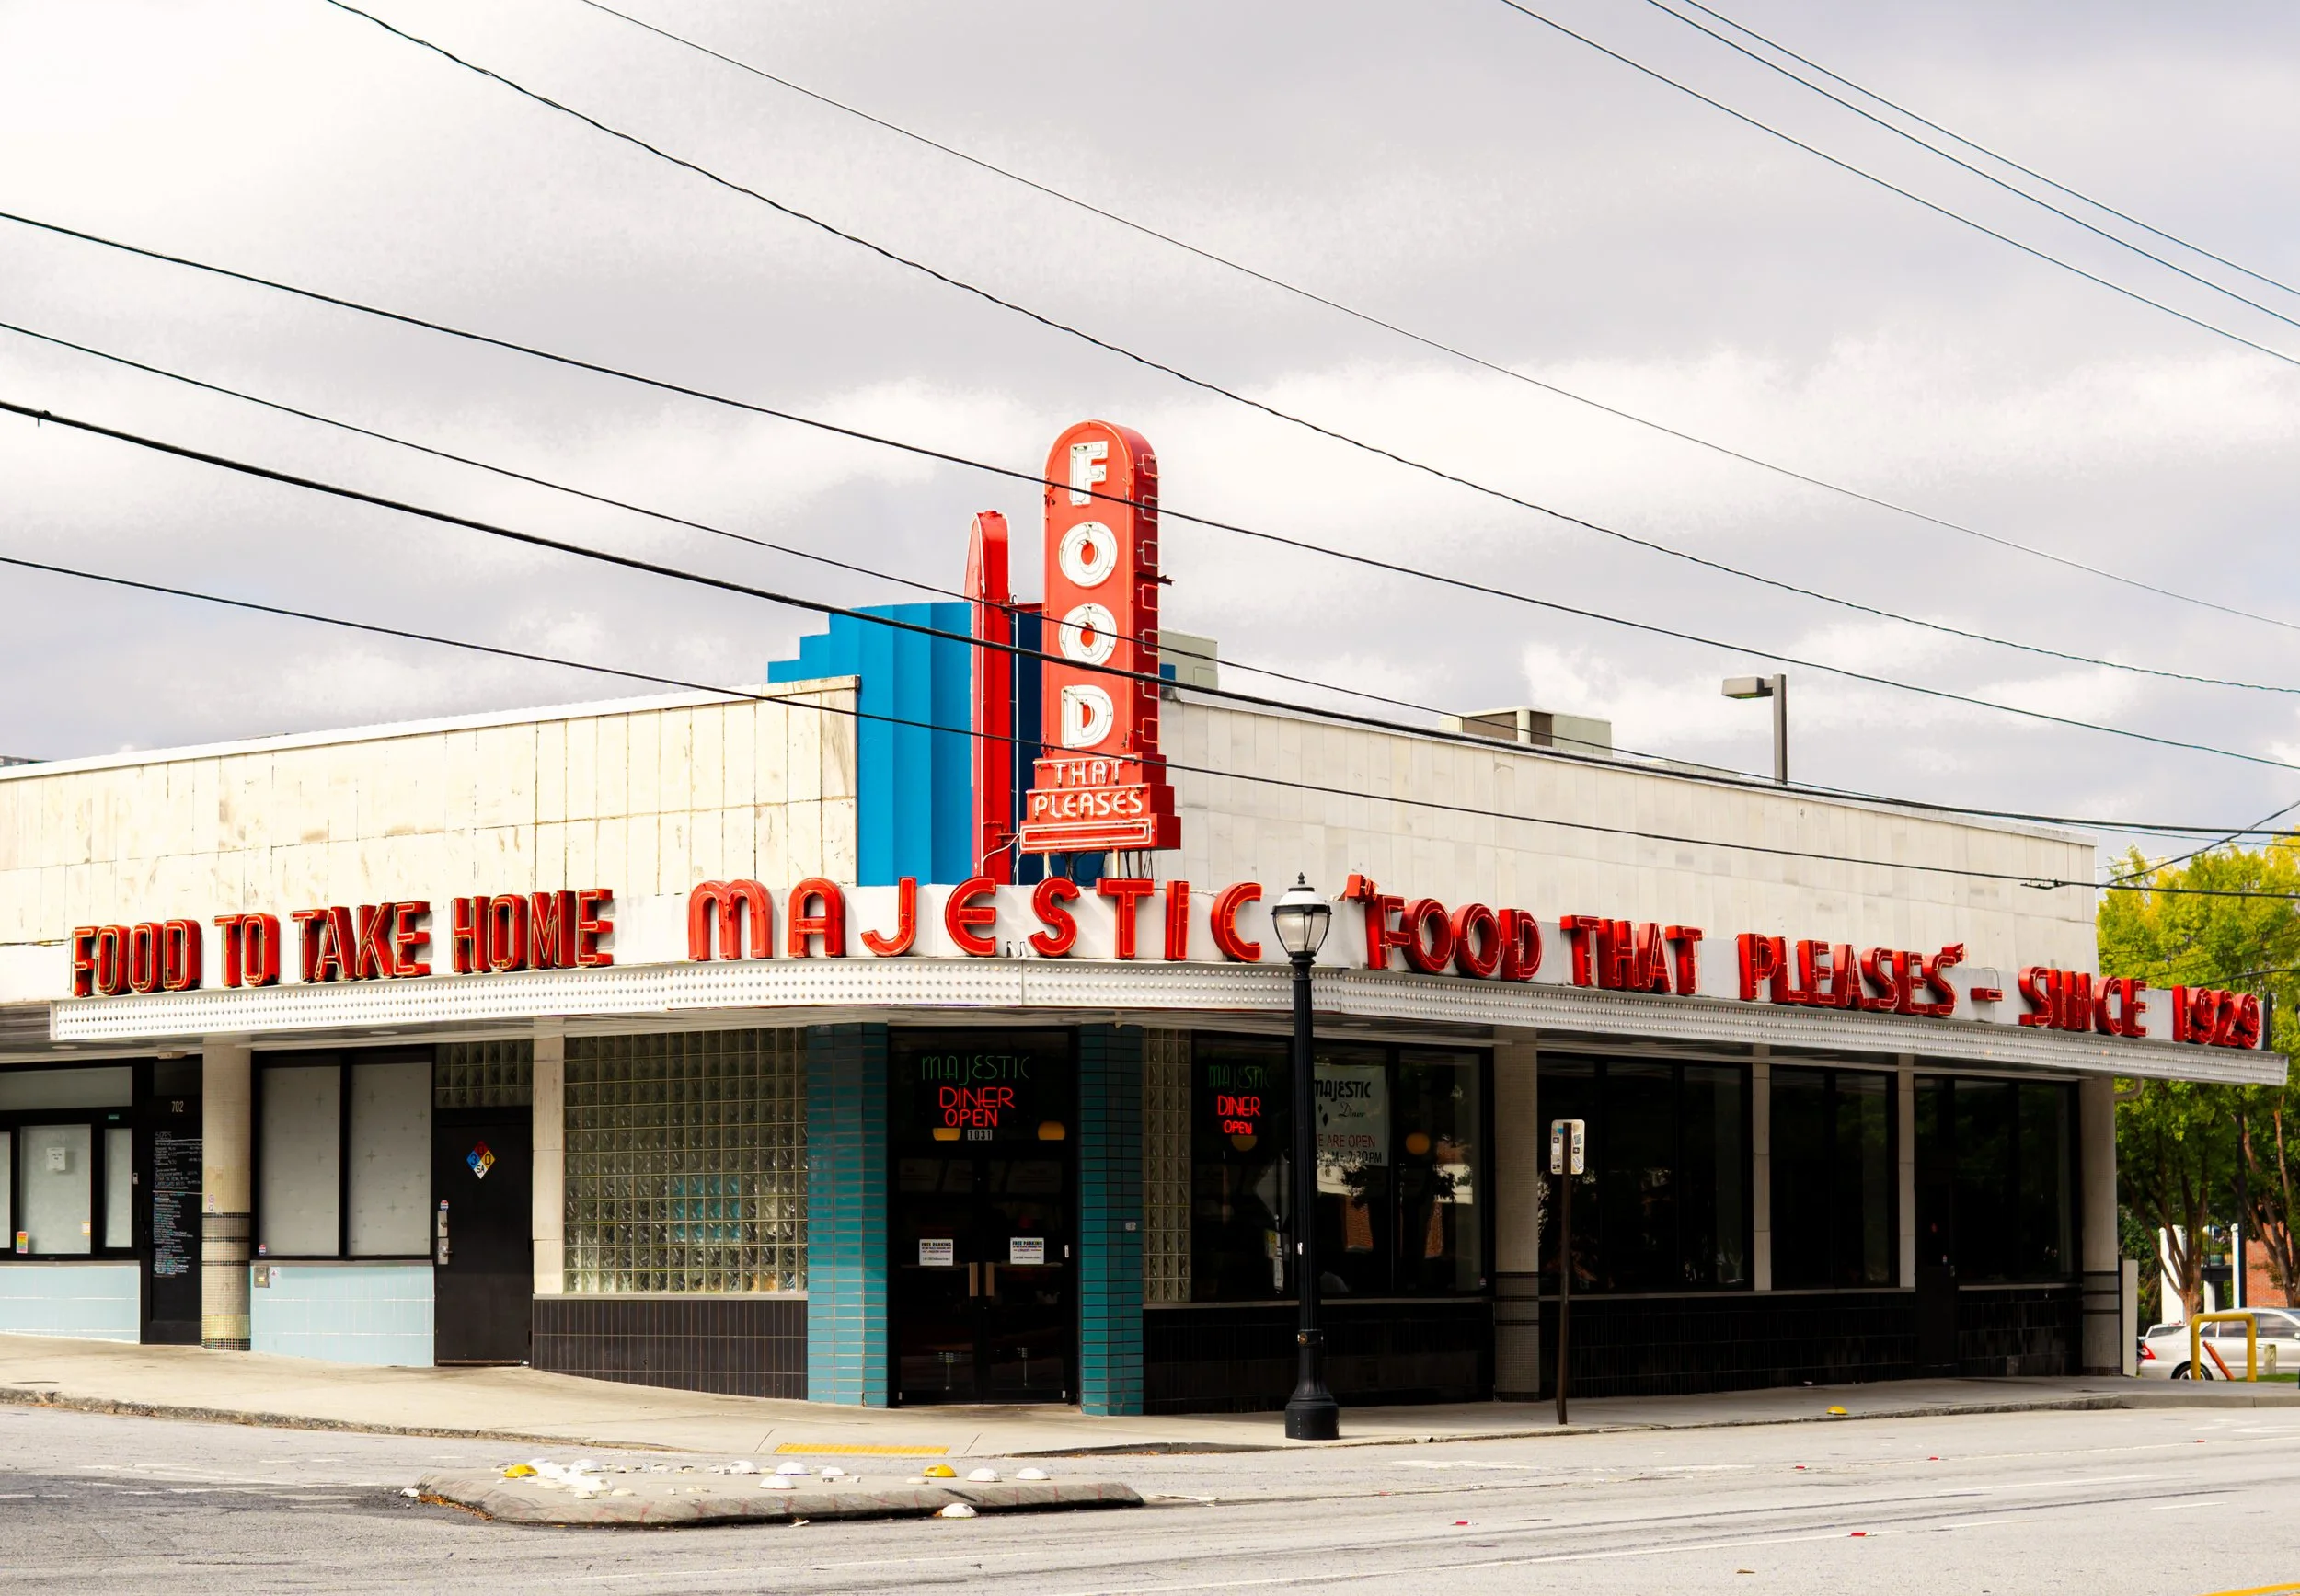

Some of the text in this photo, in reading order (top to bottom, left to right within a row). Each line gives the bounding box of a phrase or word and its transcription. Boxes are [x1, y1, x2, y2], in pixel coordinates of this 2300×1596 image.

[1059, 441, 1117, 748] FOOD
[1053, 759, 1124, 786] THAT
[1032, 790, 1144, 821] PLEASES
[687, 877, 1263, 962] MAJESTIC
[70, 888, 615, 997] FOOD TO TAKE HOME
[1560, 914, 1705, 996] THAT
[2018, 965, 2149, 1038] SINCE
[2172, 983, 2262, 1050] 1929
[922, 1055, 1030, 1086] MAJESTIC
[939, 1086, 1016, 1108] DINER
[1314, 1079, 1372, 1102] MAJESTIC
[171, 1101, 184, 1112] 702
[1217, 1095, 1261, 1117] DINER
[1338, 1101, 1366, 1119] Diner
[945, 1108, 998, 1127] OPEN
[1224, 1119, 1253, 1135] OPEN
[968, 1130, 992, 1141] 1031
[1317, 1133, 1375, 1148] E ARE OPEN
[470, 1154, 477, 1165] 3
